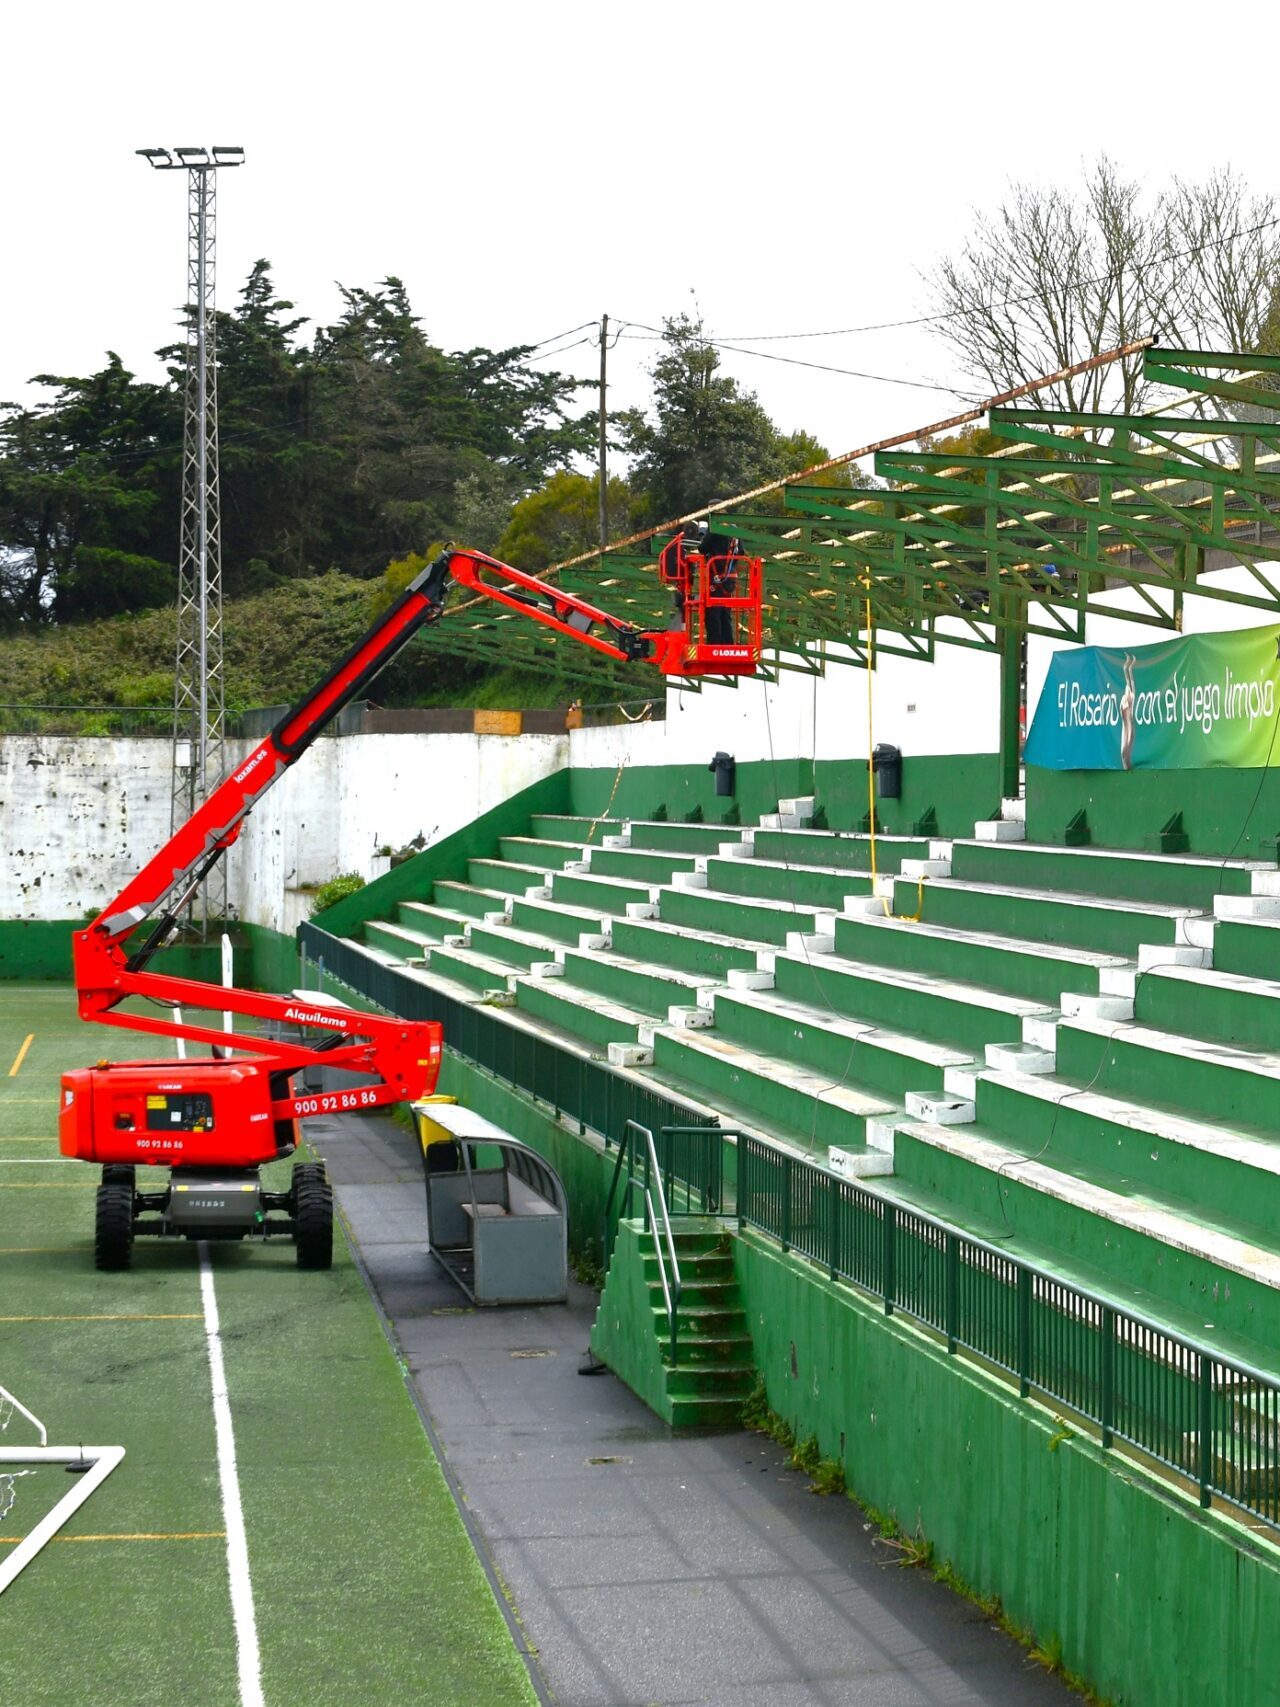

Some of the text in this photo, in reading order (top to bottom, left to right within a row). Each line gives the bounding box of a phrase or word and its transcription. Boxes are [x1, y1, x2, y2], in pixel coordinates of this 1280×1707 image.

[1057, 666, 1275, 734] El Rosario con el juego limpio
[234, 749, 268, 784] loxam.es
[294, 1091, 377, 1115] 900 92 86 86
[136, 1139, 183, 1149] 900 92 86 86
